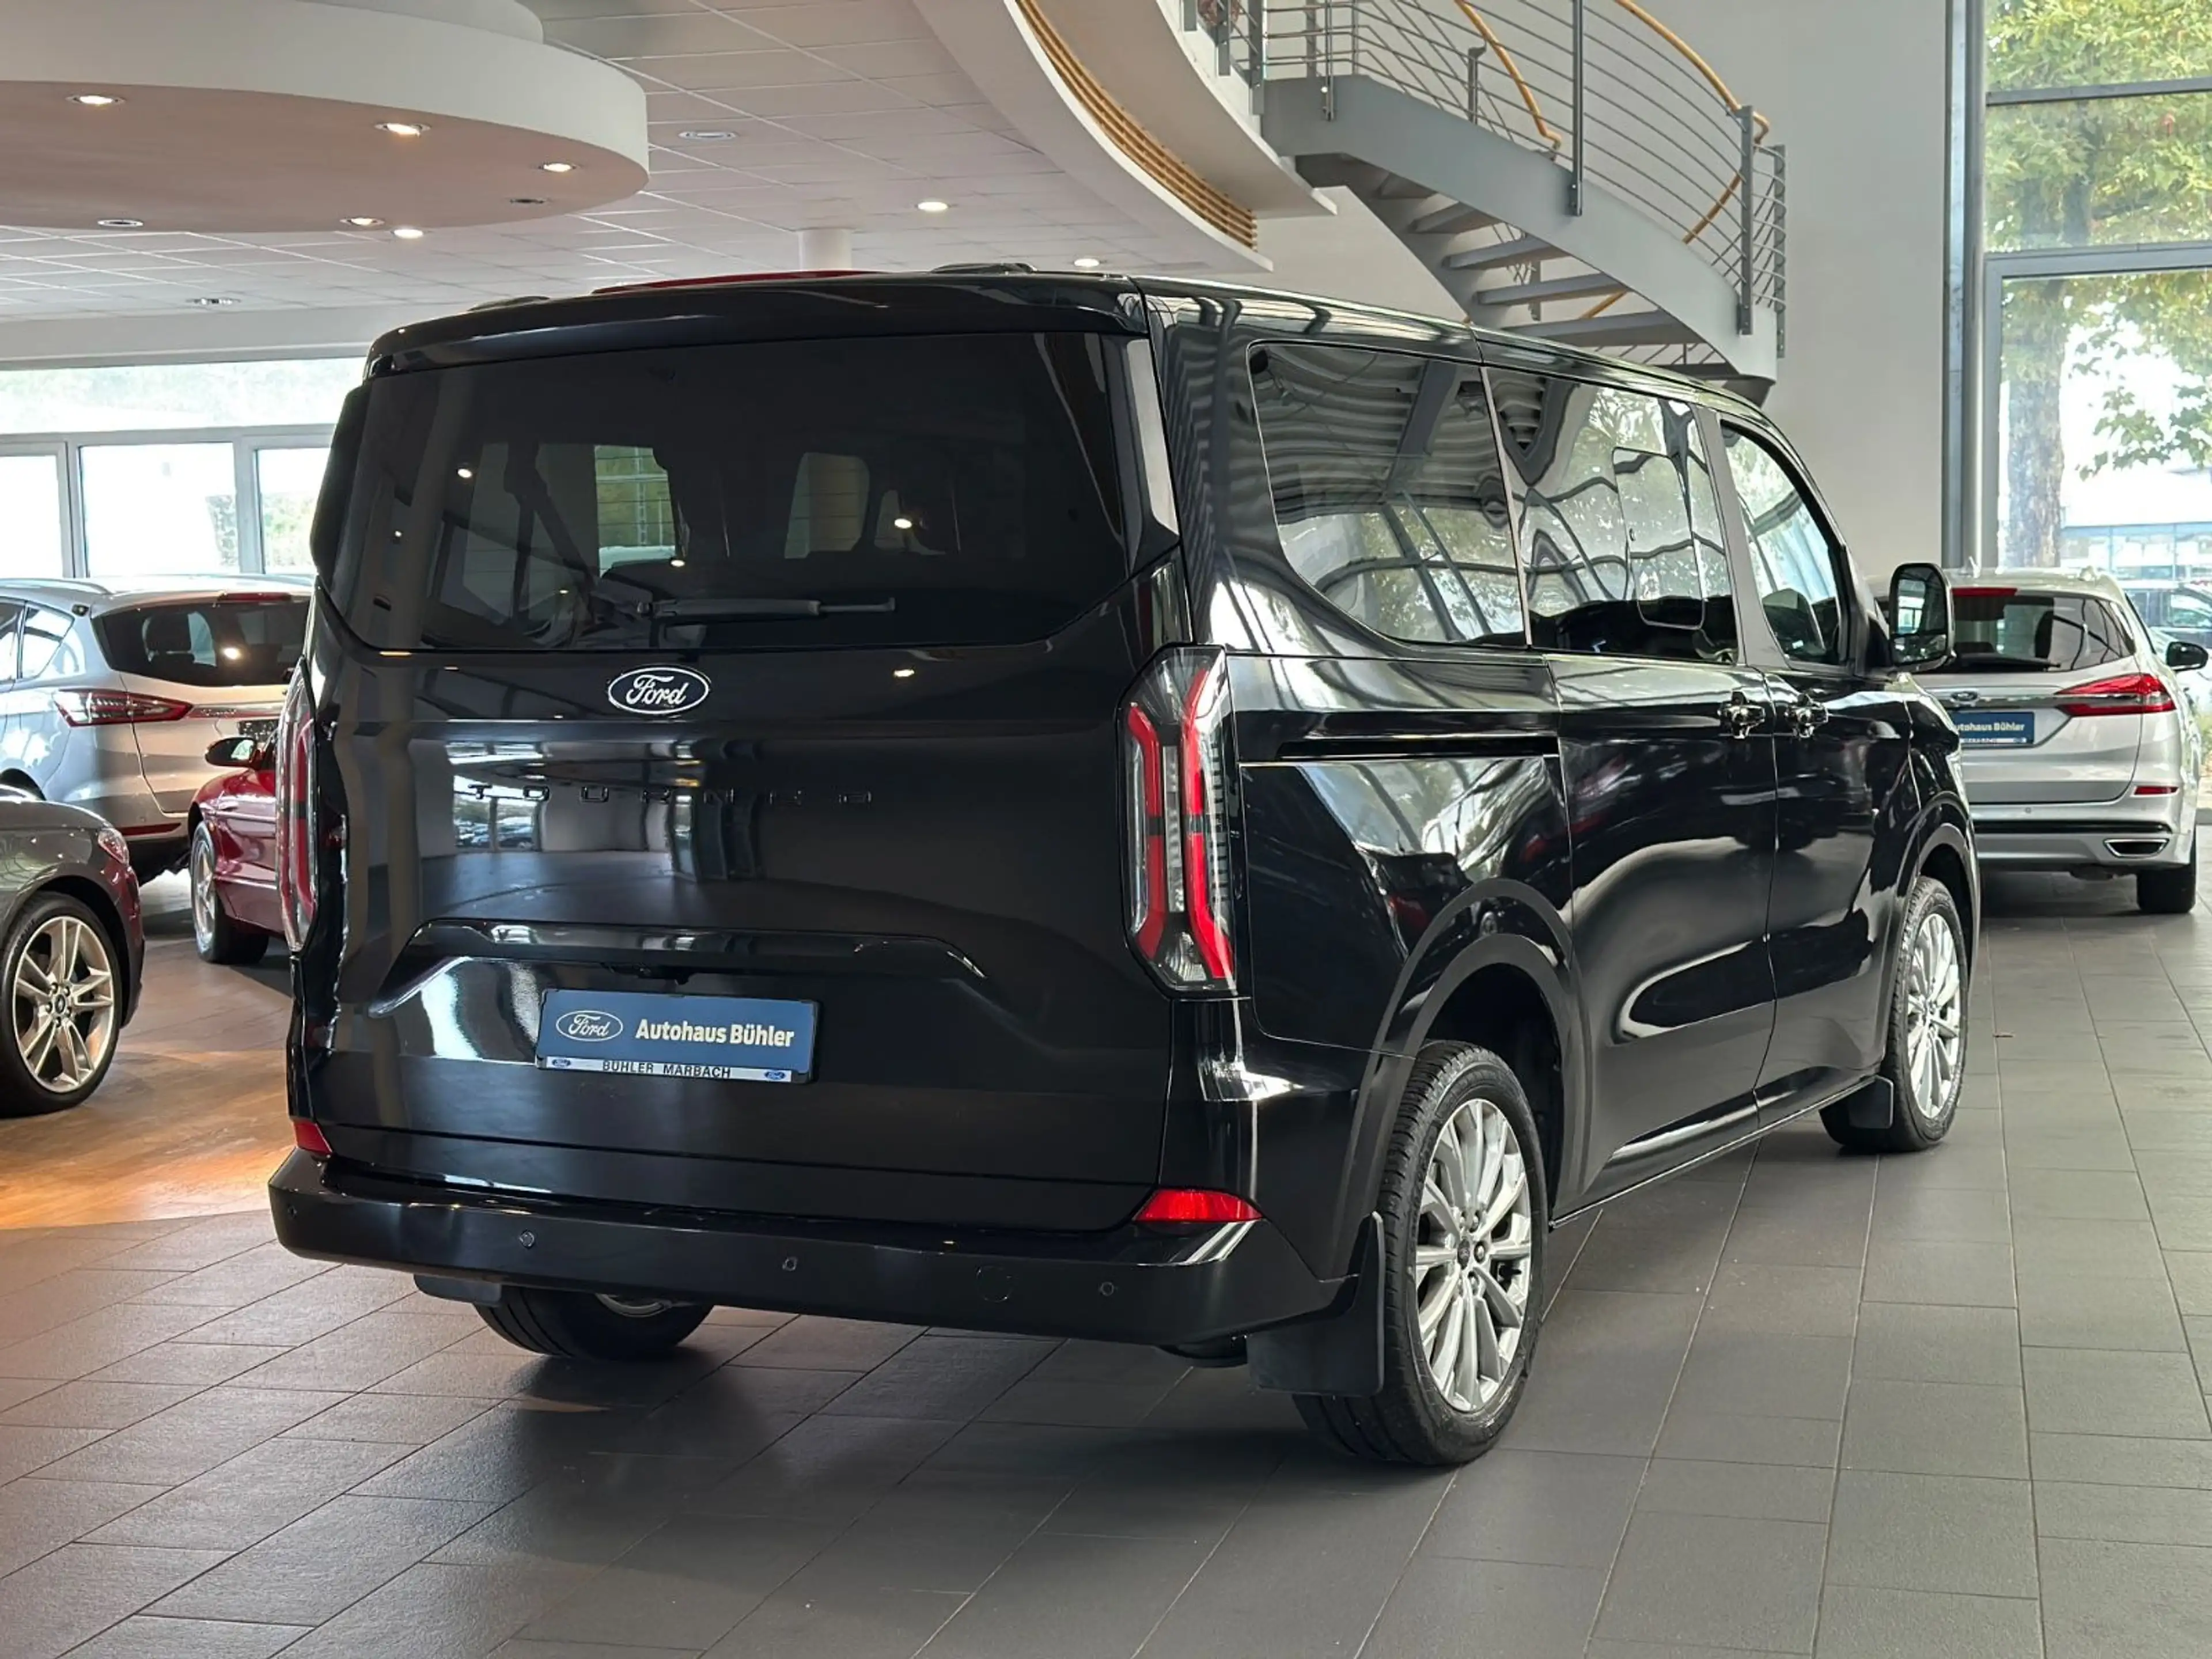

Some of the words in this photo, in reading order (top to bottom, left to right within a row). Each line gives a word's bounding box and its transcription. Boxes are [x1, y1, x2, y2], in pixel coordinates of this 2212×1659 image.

[626, 675, 689, 704] Ford
[1954, 722, 1993, 732] utohaus
[568, 1014, 611, 1036] Ford
[635, 1019, 727, 1043] Autohaus
[729, 1023, 794, 1047] Bühler
[663, 1064, 731, 1080] MARBACH
